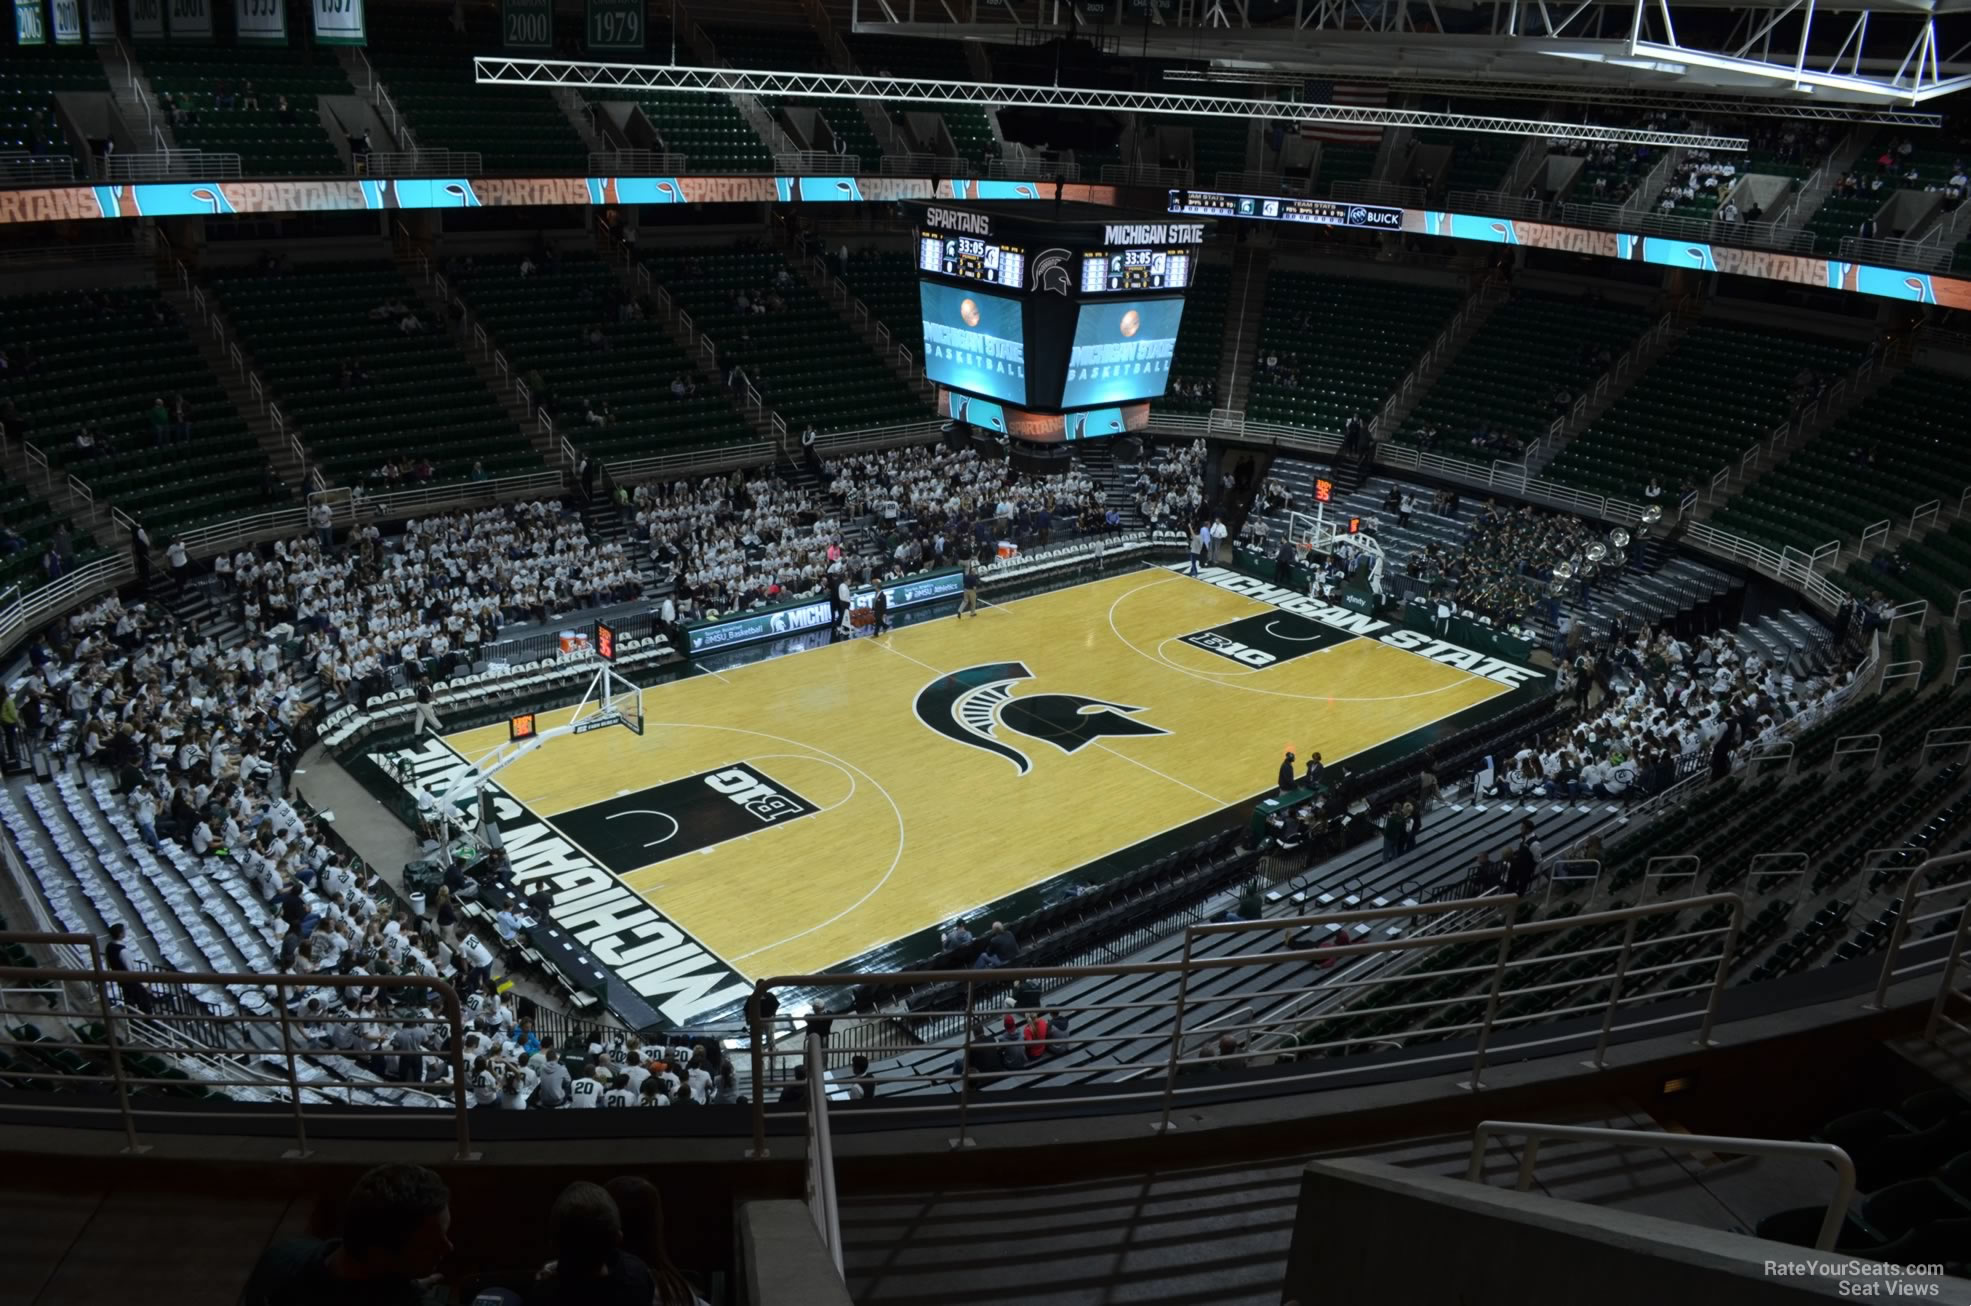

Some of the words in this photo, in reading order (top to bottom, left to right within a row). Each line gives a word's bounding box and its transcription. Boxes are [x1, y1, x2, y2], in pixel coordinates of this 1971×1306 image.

[508, 13, 547, 42] 2000
[594, 11, 639, 42] 1979
[227, 181, 364, 213] SPARTANS
[471, 178, 589, 206] SPARTANS
[680, 177, 779, 203] SPARTANS
[926, 207, 989, 235] SPARTANS
[1367, 212, 1399, 224] BUICK
[1103, 224, 1167, 246] MICHIGAN
[1168, 224, 1204, 243] STATE
[1515, 221, 1618, 258] SPARTANS
[959, 239, 984, 255] 33:05
[946, 261, 953, 273] 0
[1125, 251, 1151, 265] 33:05
[1712, 247, 1828, 287] SPARTANS
[986, 268, 994, 281] 0
[1112, 277, 1118, 289] 0
[1154, 275, 1160, 287] 0
[923, 320, 984, 355] MICHIGAN
[984, 333, 1024, 364] STATE
[925, 342, 1024, 379] BASKETBALL
[1069, 341, 1137, 368] MICHIGAN
[1136, 338, 1176, 360] STATE
[1067, 360, 1170, 381] BASKETBALL
[1009, 417, 1064, 435] SPARTANS
[1346, 594, 1366, 607] xfinity
[704, 624, 763, 645] @MSU_Basketball
[1165, 560, 1391, 635] MICHIGAN
[1379, 628, 1546, 689] STATE
[499, 822, 756, 1027] MICHIGAN
[388, 936, 398, 950] 20
[466, 936, 480, 950] 20
[468, 997, 480, 1012] 20
[674, 1050, 688, 1062] 20
[574, 1082, 594, 1095] 20
[608, 1095, 626, 1107] 20
